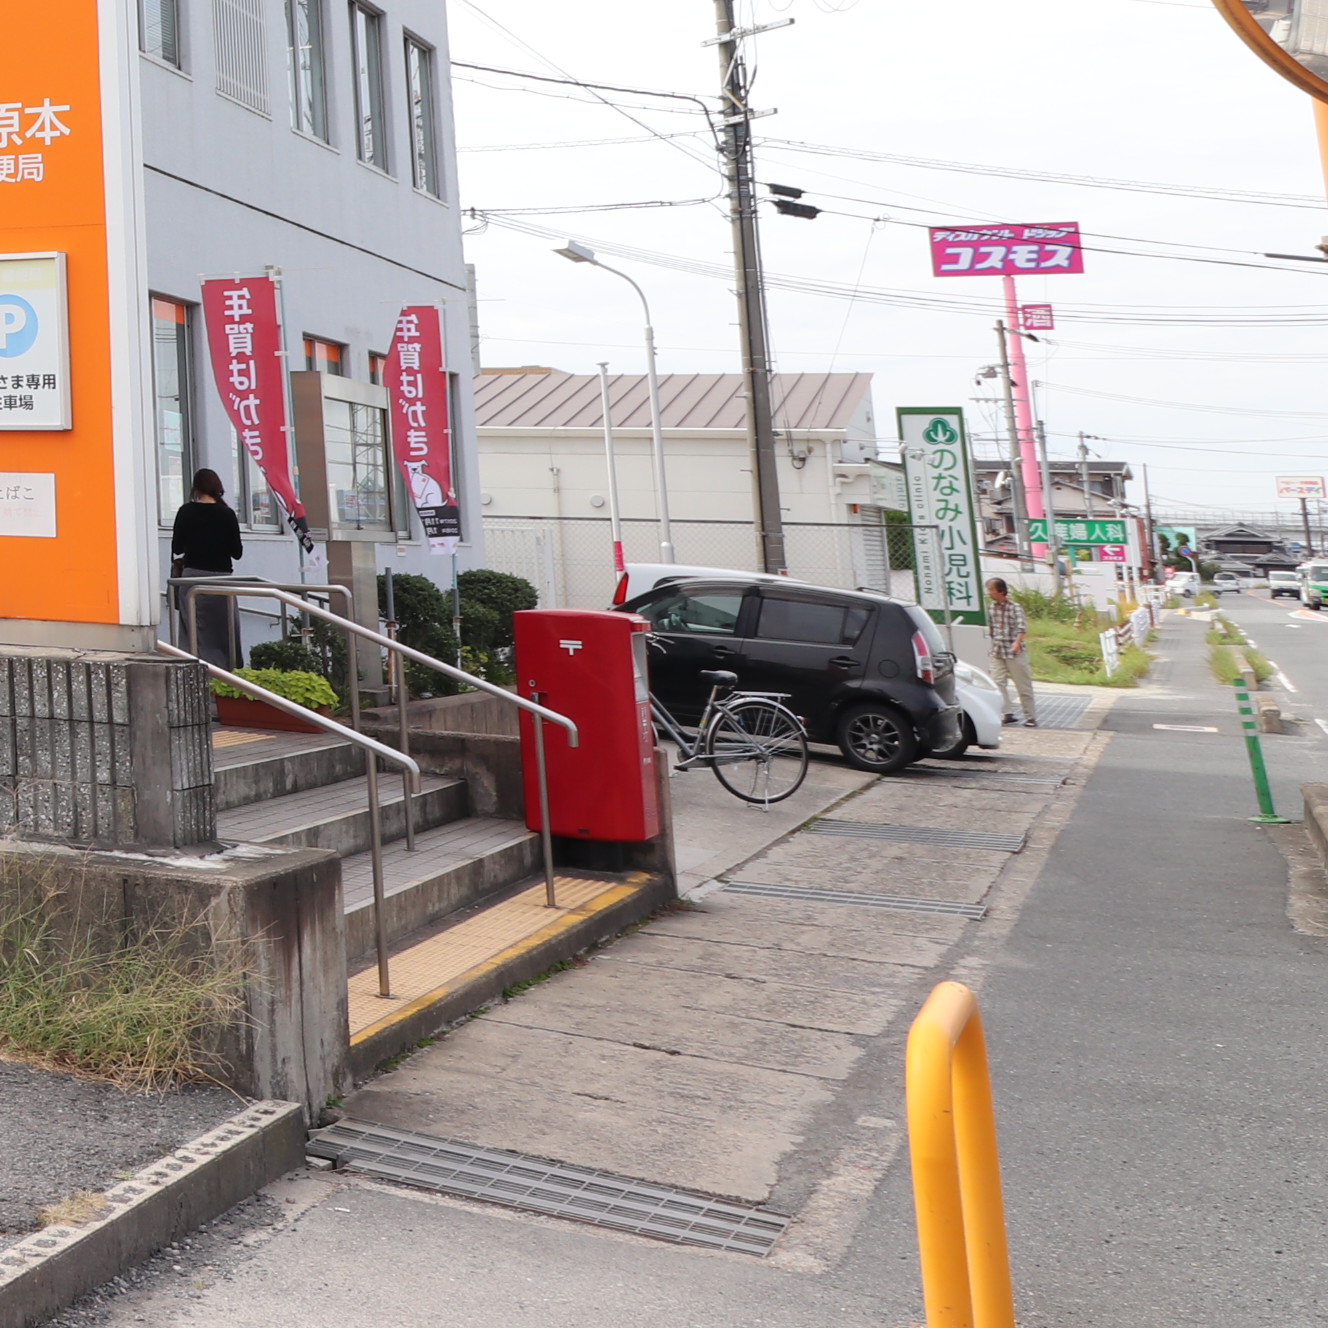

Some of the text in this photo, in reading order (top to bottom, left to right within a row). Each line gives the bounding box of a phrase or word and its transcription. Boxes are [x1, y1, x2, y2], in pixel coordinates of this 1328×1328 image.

[932, 229, 1015, 242] ディスカウント
[940, 244, 1074, 271] コスモス
[1025, 308, 1051, 327] 酒
[932, 448, 973, 607] のなみ小児科
